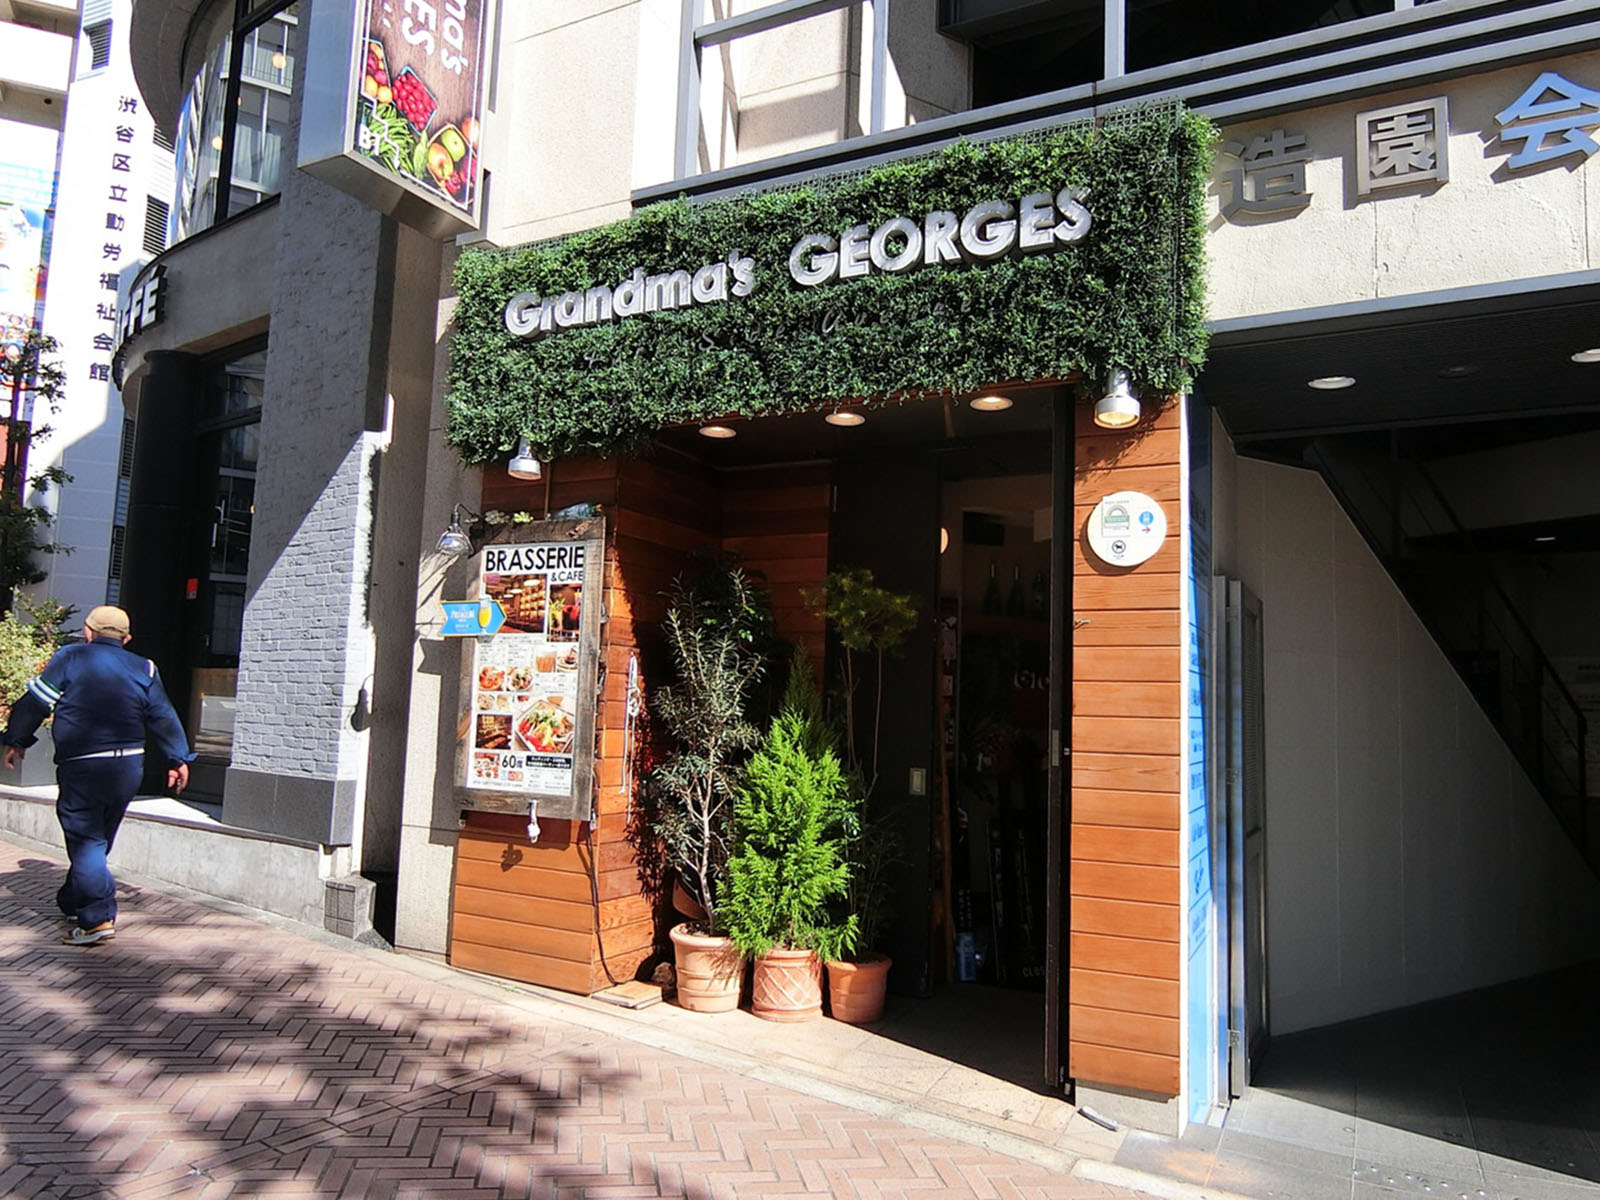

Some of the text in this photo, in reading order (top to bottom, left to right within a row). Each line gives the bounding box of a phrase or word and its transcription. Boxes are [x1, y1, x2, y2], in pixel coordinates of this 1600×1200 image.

[504, 186, 1092, 338] Grandma's GEORGES
[485, 546, 585, 572] BRASSERIE
